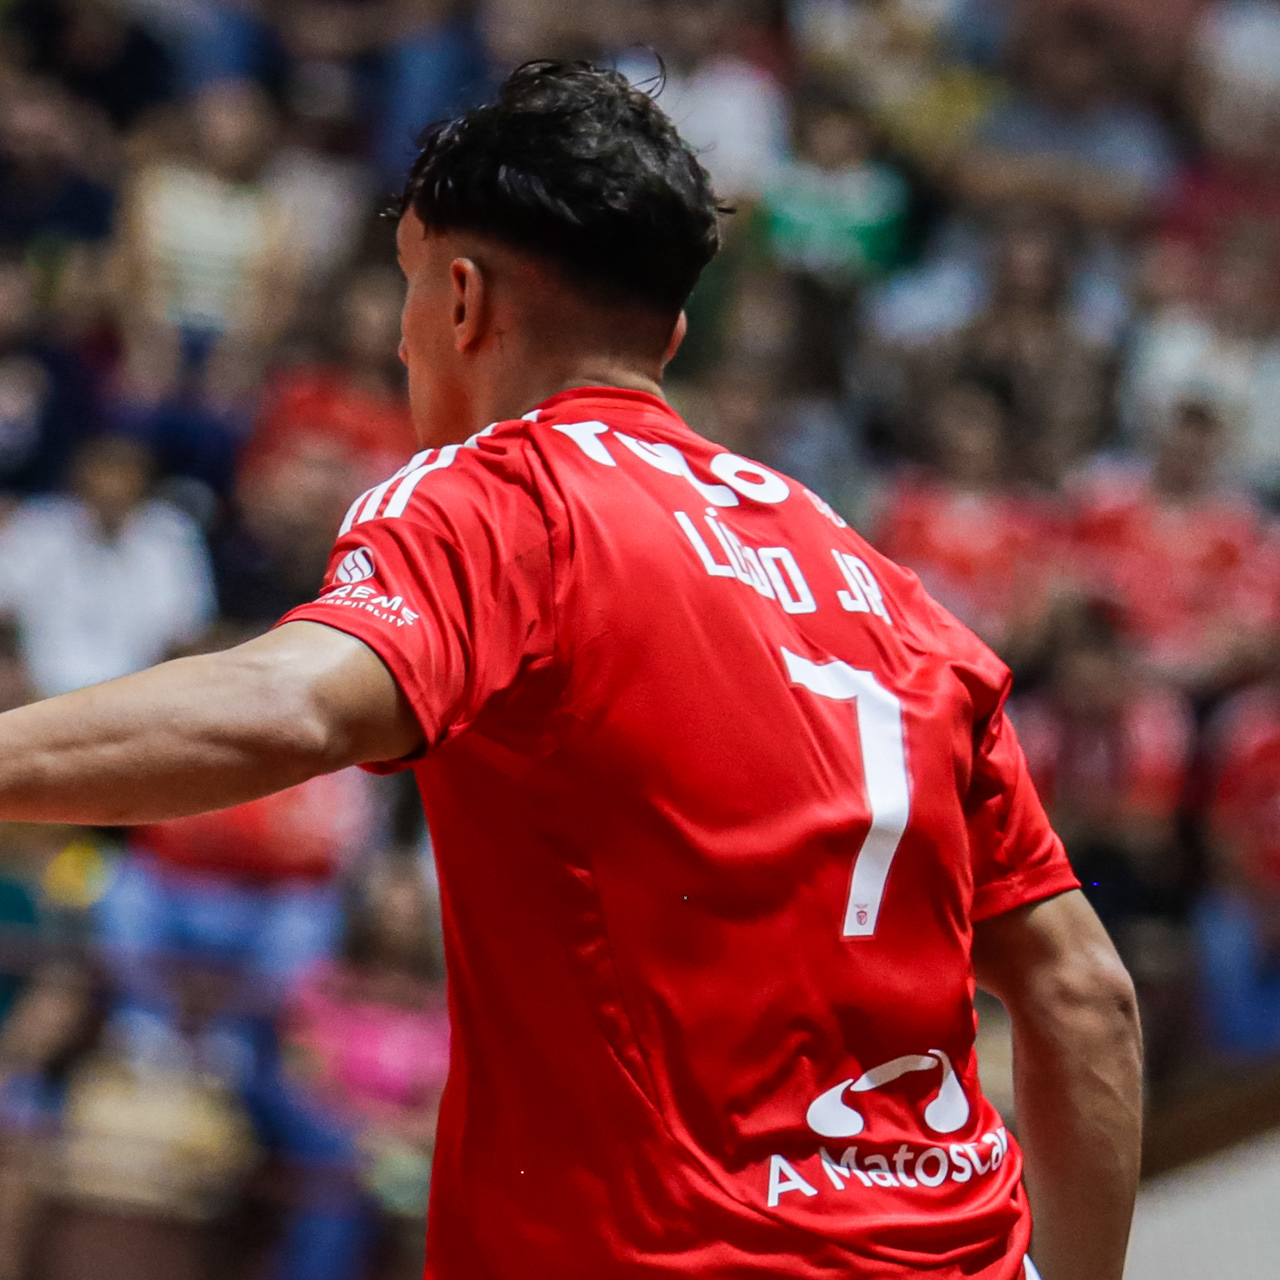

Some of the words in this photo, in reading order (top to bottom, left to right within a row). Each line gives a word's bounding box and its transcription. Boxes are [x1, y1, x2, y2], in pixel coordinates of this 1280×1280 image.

[316, 584, 419, 626] REME
[830, 548, 893, 626] JR
[779, 645, 911, 938] 7
[767, 1154, 818, 1208] A
